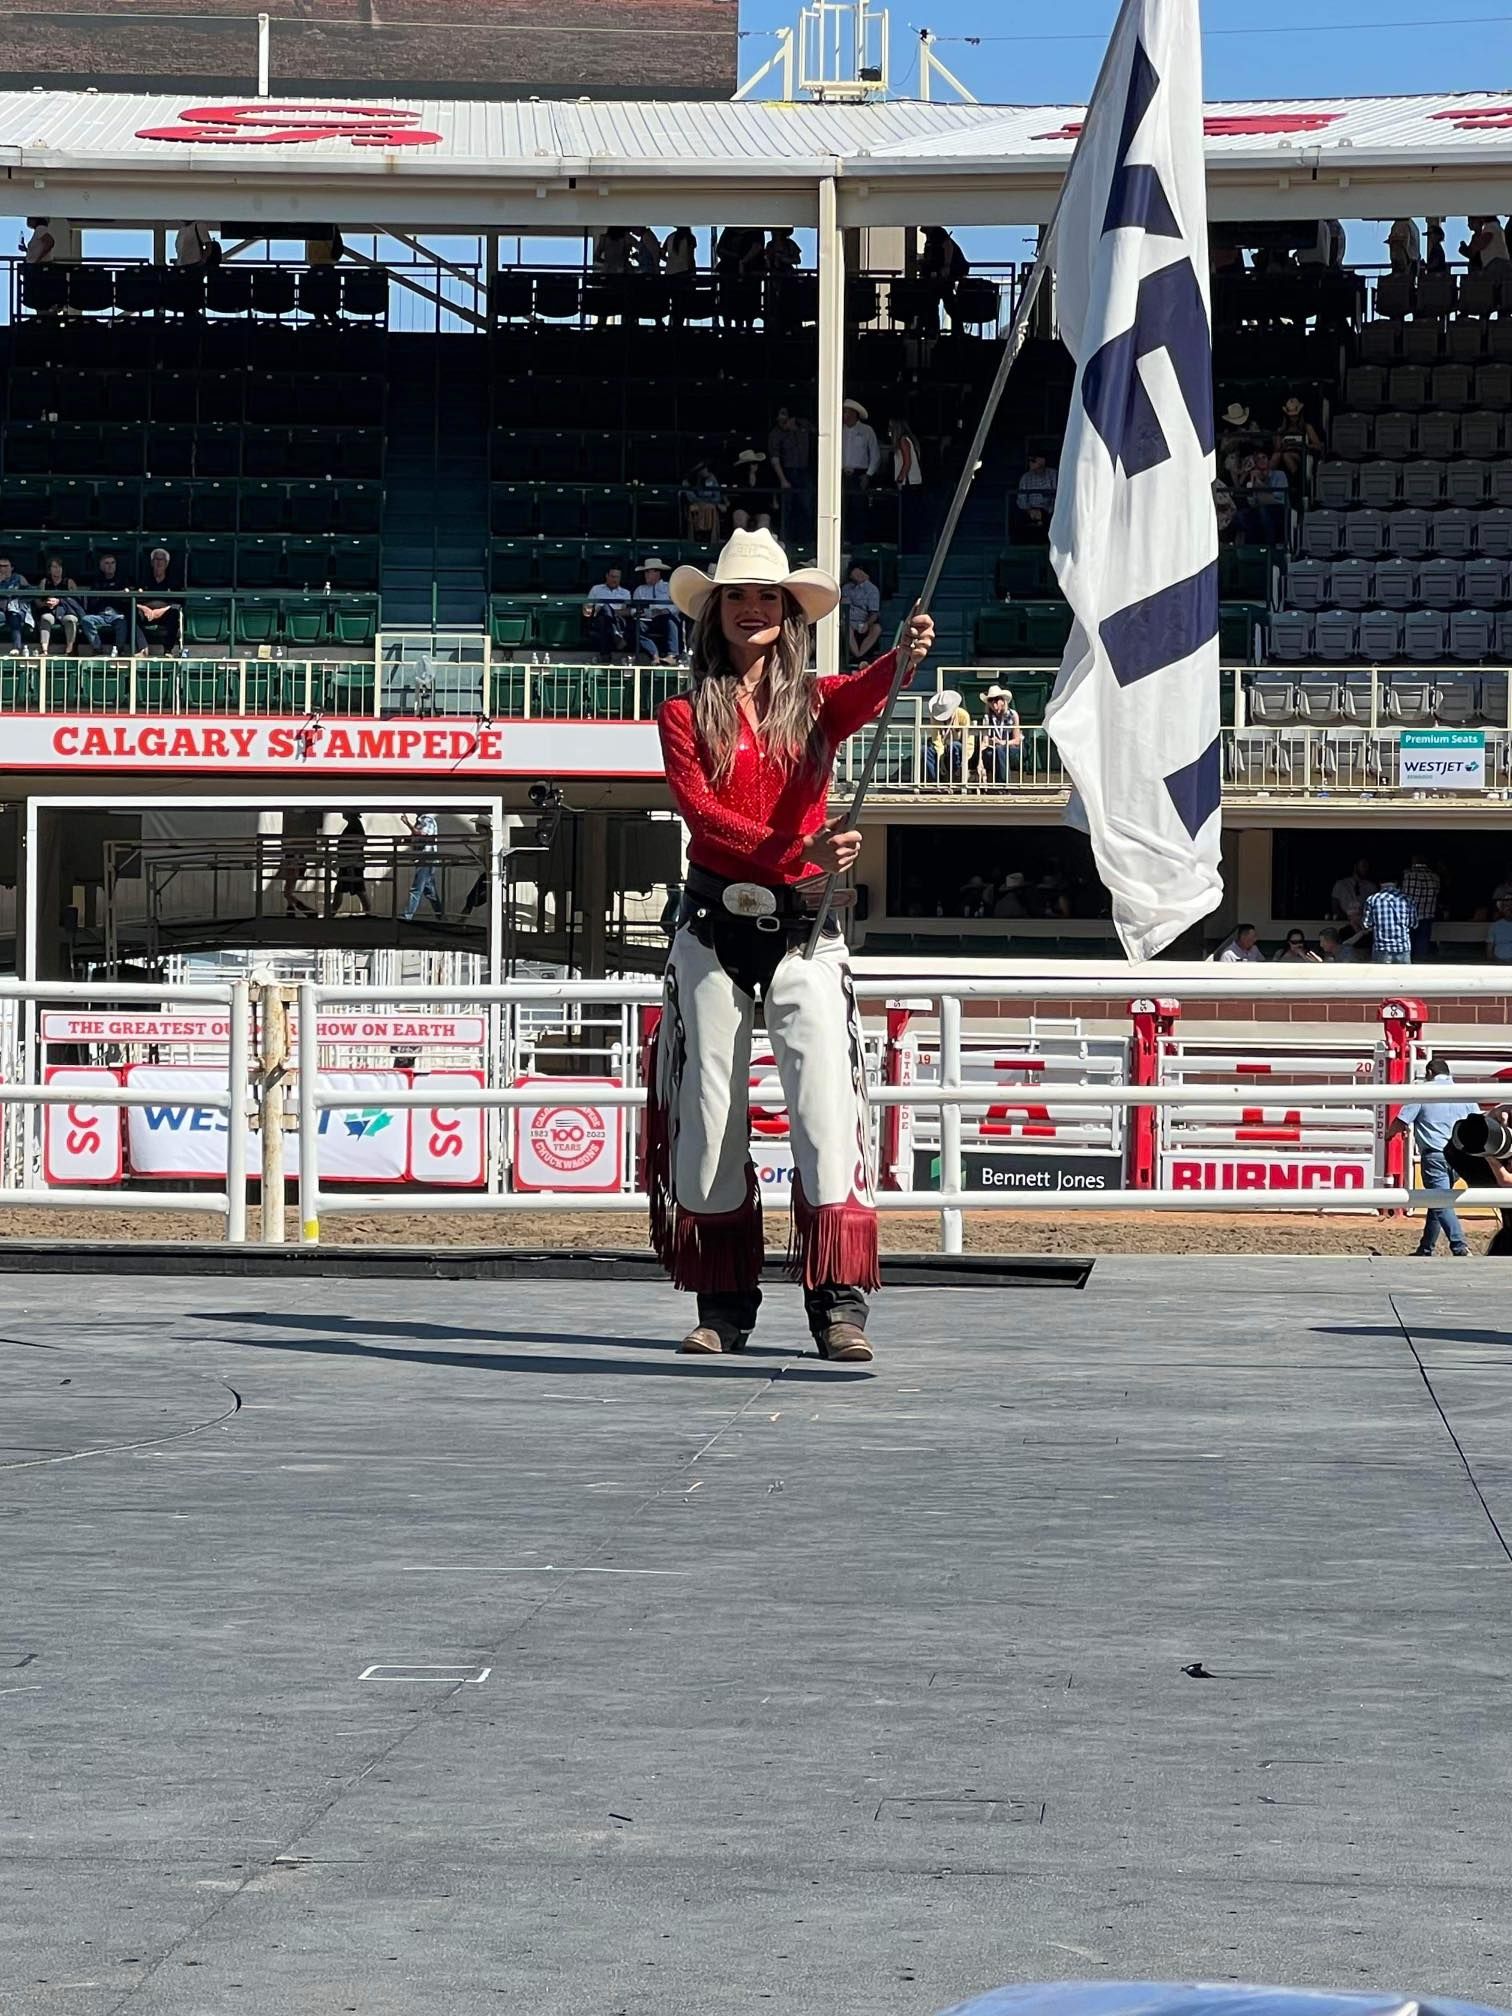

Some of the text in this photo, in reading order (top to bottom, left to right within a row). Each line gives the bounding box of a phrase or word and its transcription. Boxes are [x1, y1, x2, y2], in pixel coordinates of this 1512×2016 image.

[53, 727, 503, 760] CALGARY STAMPEDE
[1405, 734, 1478, 744] Premium Seats
[1404, 762, 1463, 775] WESTJET
[68, 1021, 104, 1034] THE
[109, 1021, 207, 1036] GREATEST
[317, 1023, 358, 1036] HOW
[362, 1023, 388, 1037] ON
[393, 1024, 456, 1037] EARTH
[918, 1054, 931, 1065] 19
[1356, 1062, 1372, 1074] 20
[550, 1125, 584, 1141] 100
[553, 1143, 581, 1151] YEARS
[535, 1142, 600, 1169] CHUCKWAGONS
[981, 1168, 1105, 1191] Bennett Jones
[1172, 1162, 1365, 1189] BURNCO
